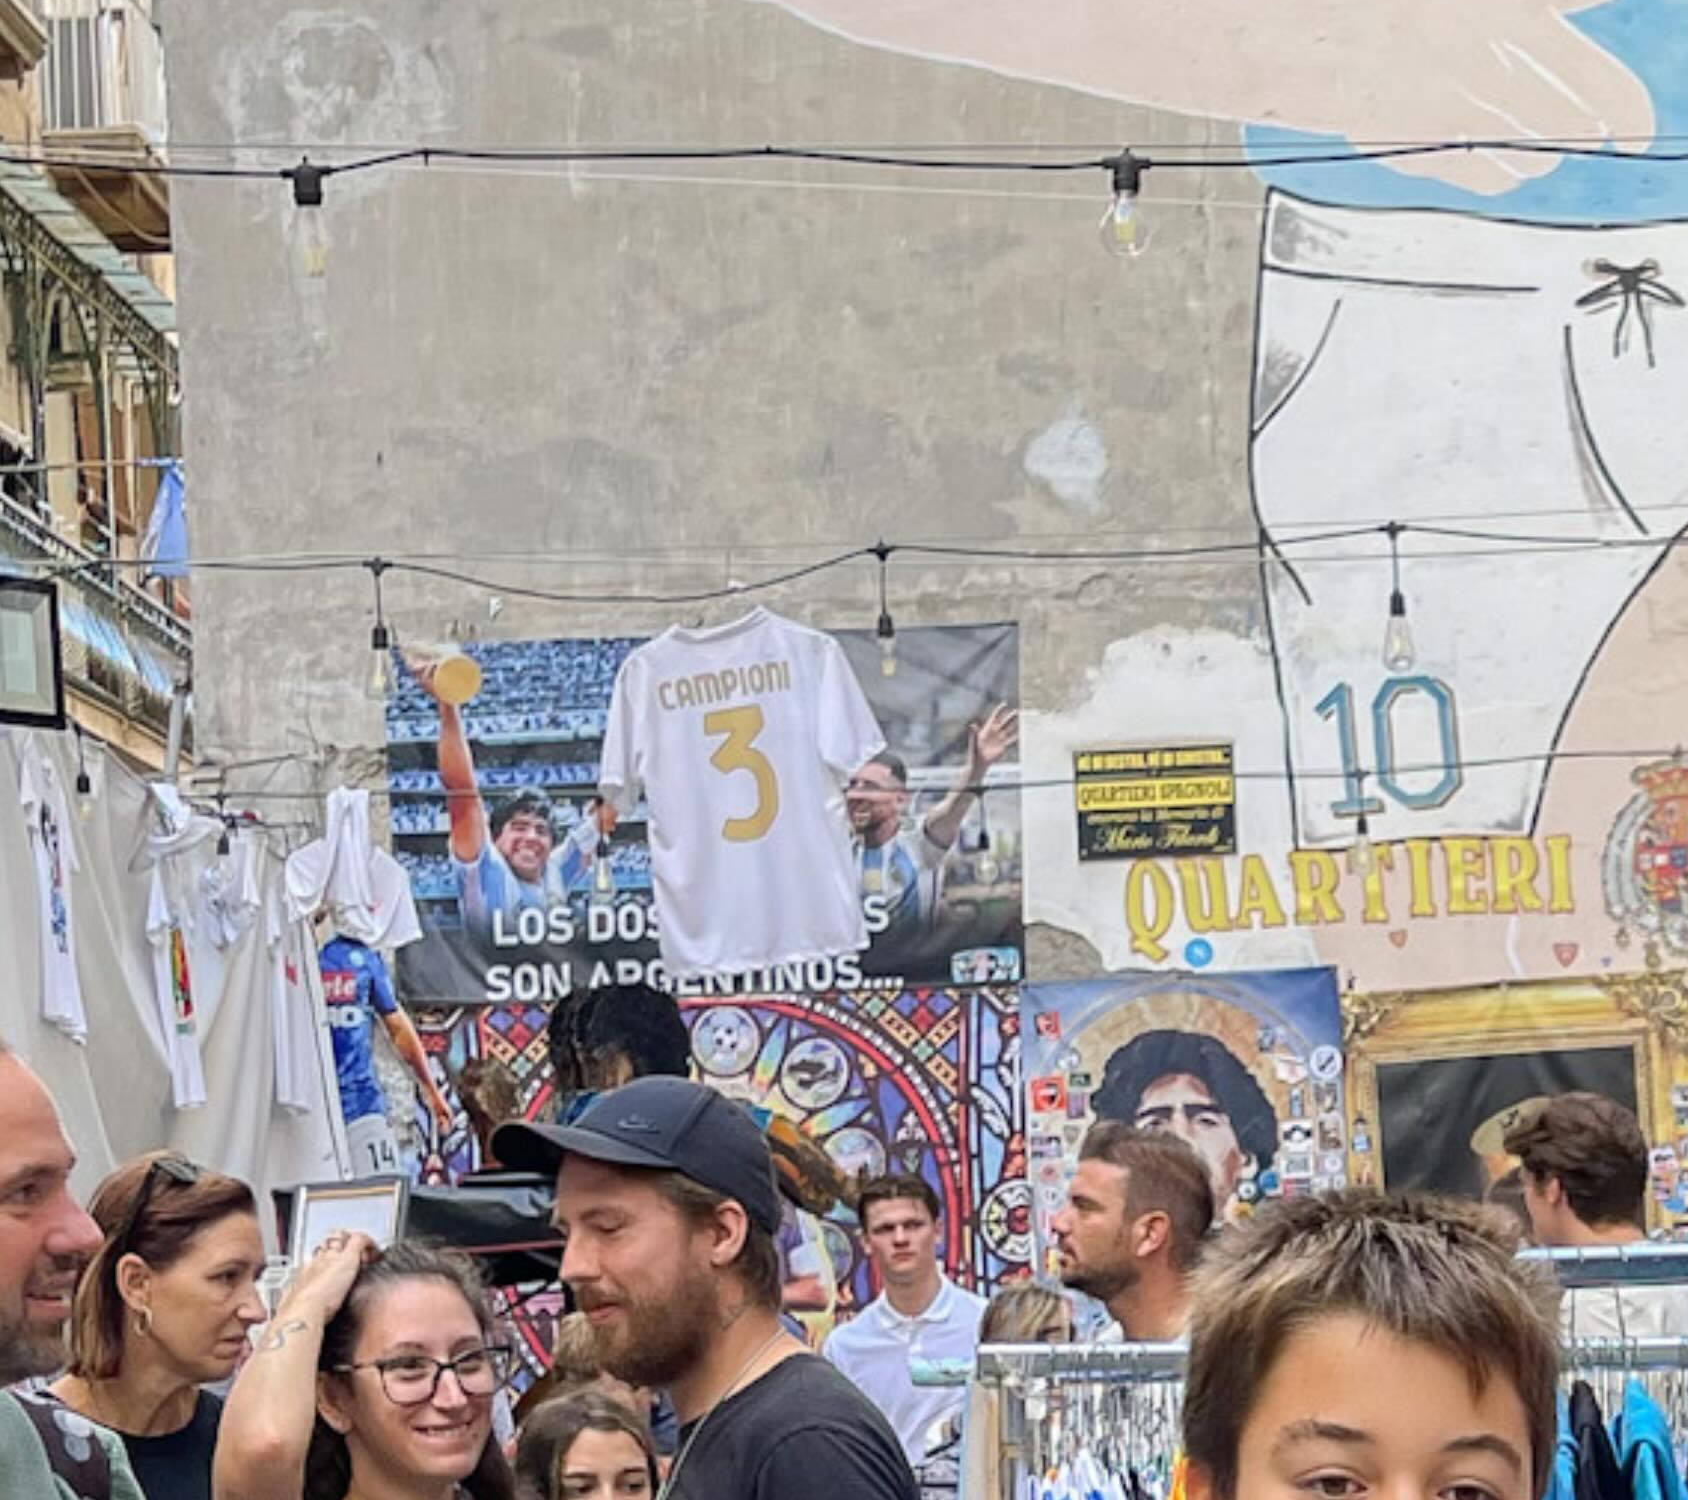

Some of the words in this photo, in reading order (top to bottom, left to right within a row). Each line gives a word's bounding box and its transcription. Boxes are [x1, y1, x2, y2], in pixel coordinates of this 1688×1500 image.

[659, 661, 791, 710] CAMPIONI
[1314, 675, 1463, 817] 10
[704, 703, 779, 843] 3
[1124, 835, 1576, 962] QUARTIERI
[493, 905, 574, 946] LOS
[486, 963, 572, 1001] SON
[367, 1140, 396, 1171] 14
